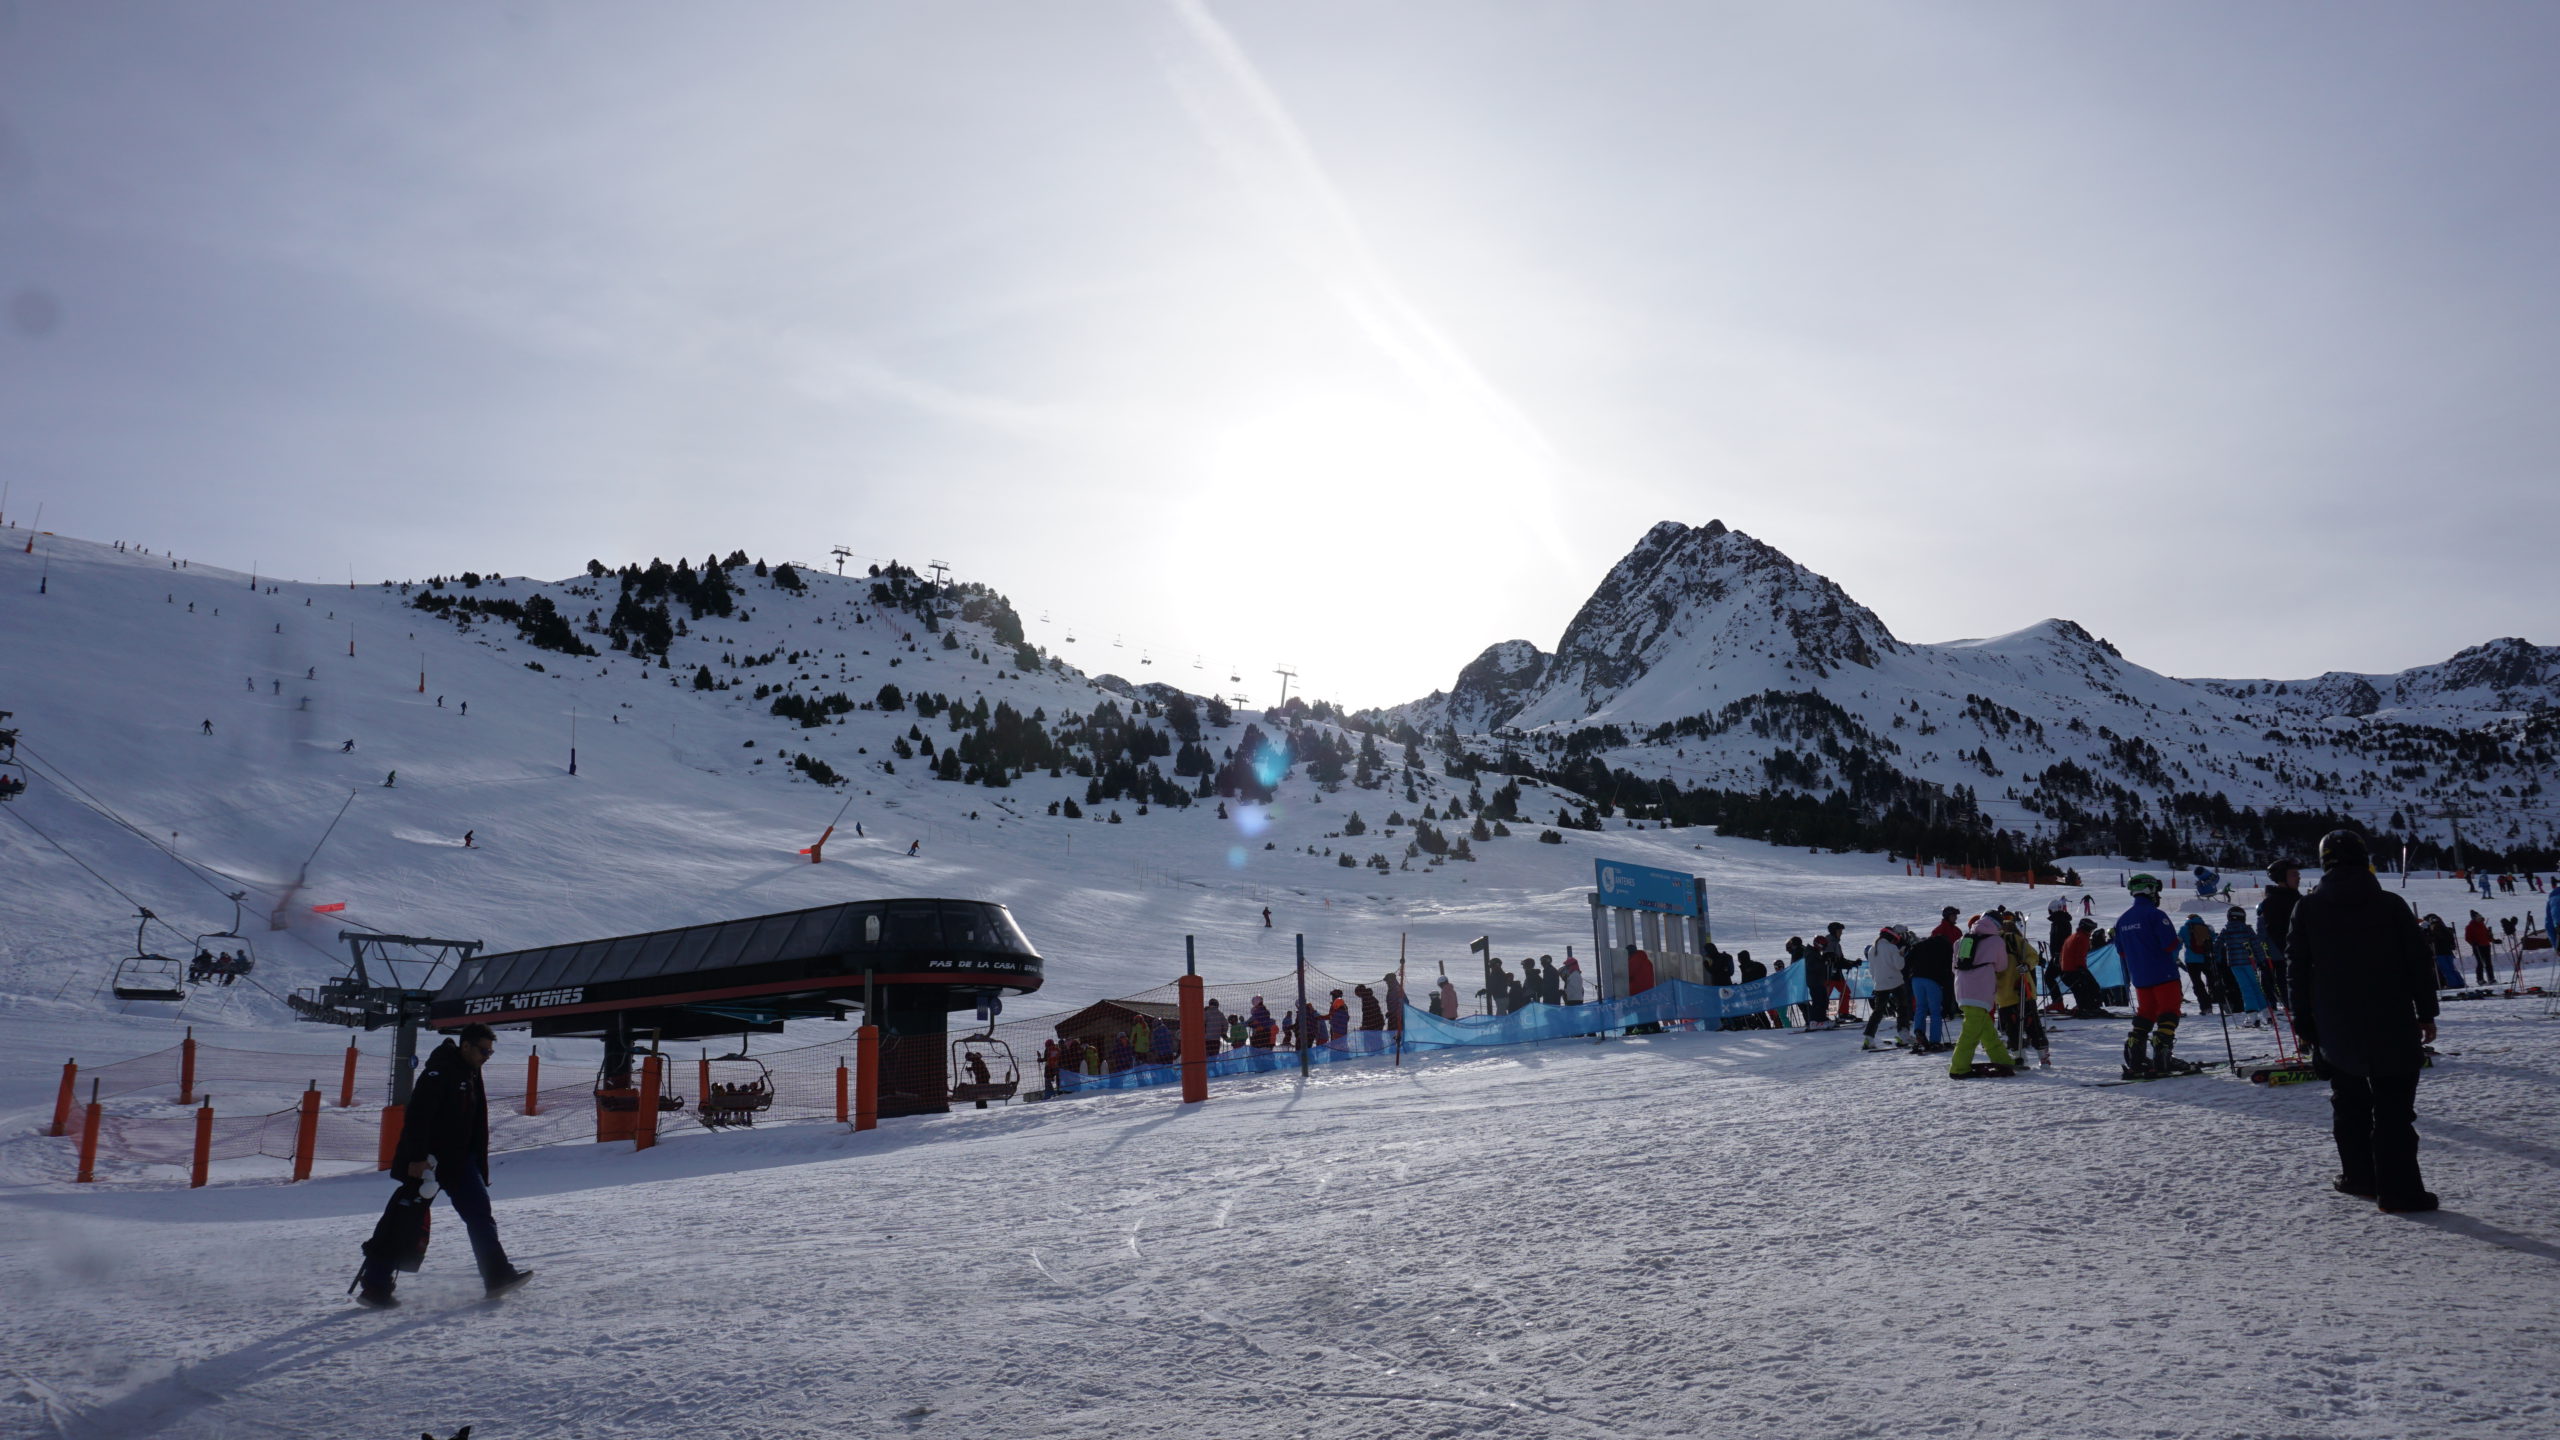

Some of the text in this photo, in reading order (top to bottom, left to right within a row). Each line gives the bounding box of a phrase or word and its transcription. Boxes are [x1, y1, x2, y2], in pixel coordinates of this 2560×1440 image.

[929, 960, 953, 968] PAS
[958, 960, 973, 968] DE
[977, 961, 989, 969] LA
[994, 962, 1016, 970] CASA
[464, 987, 584, 1015] TSD4 ANTENES
